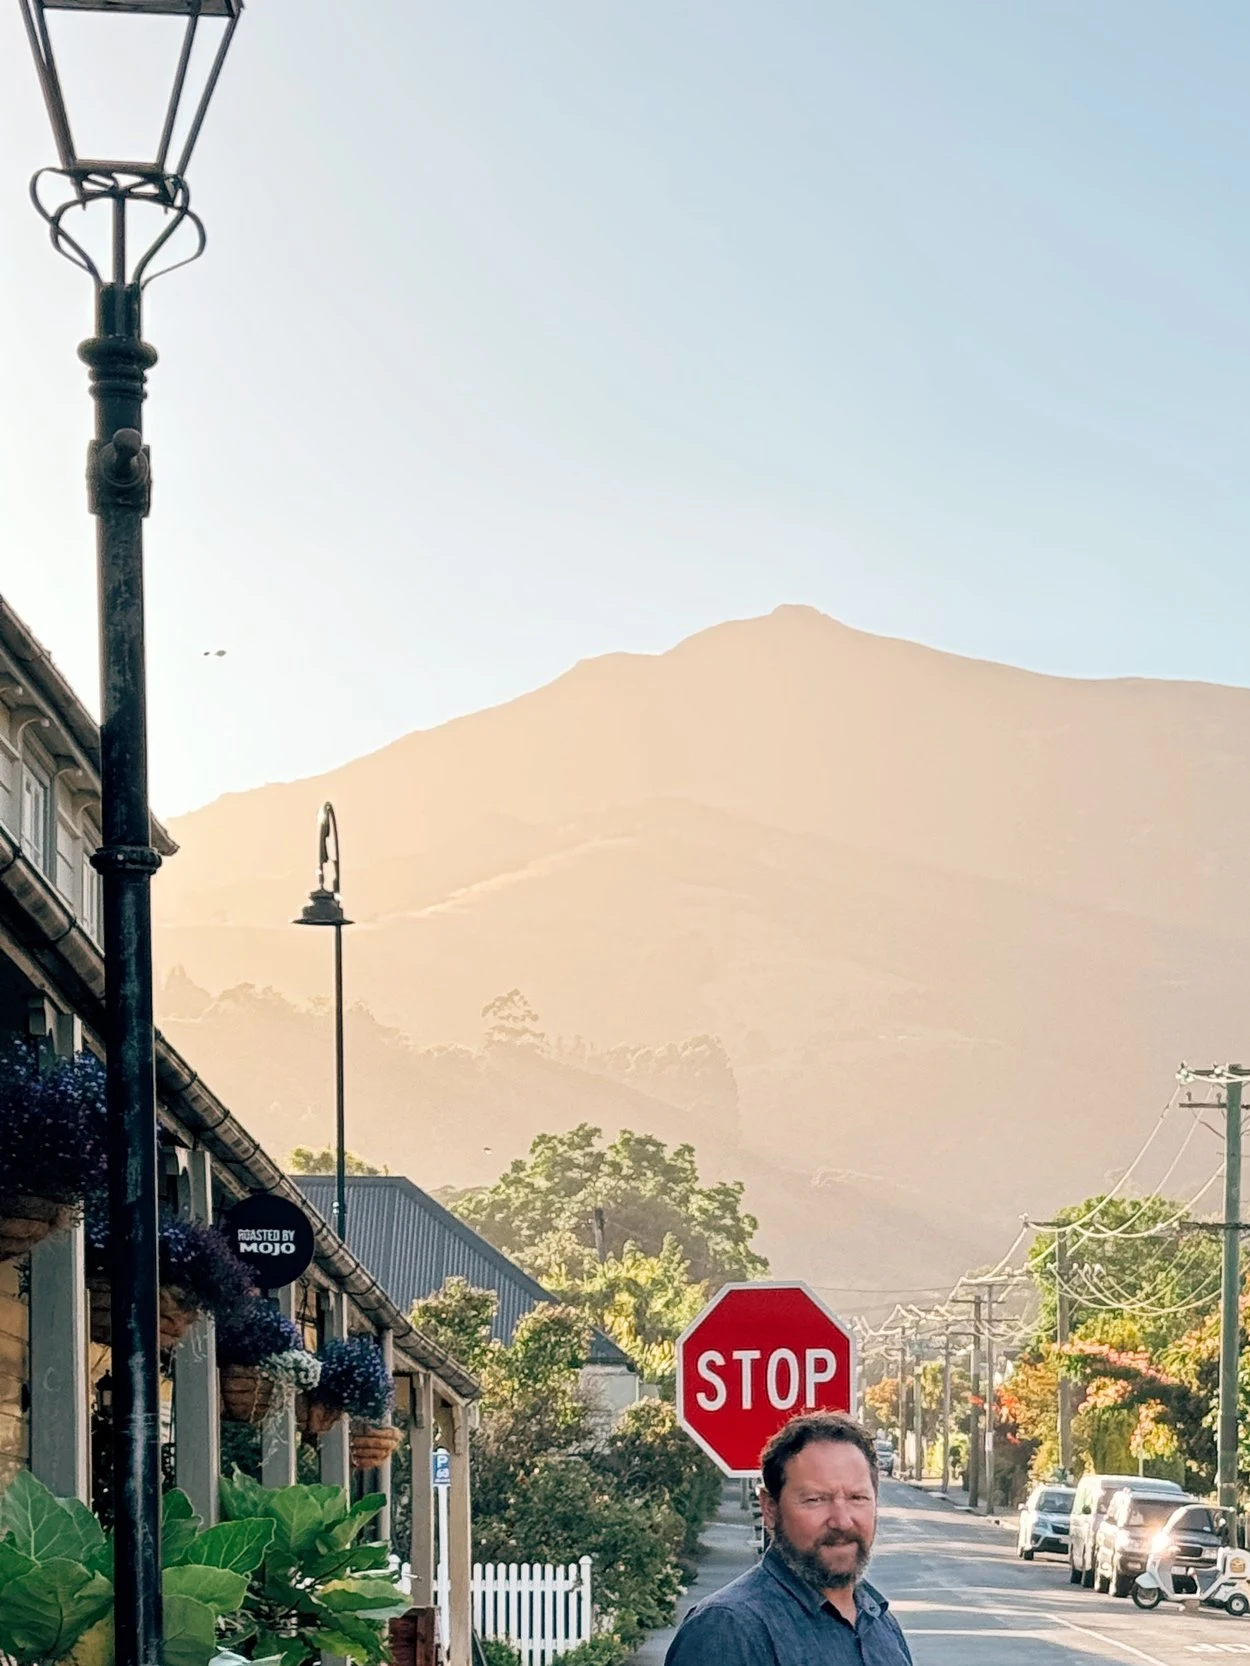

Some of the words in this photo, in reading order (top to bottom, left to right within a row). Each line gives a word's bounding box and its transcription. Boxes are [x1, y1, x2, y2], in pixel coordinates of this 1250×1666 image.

[238, 1229, 280, 1242] ROASTED
[282, 1230, 295, 1242] BY
[239, 1242, 296, 1256] MOJO
[696, 1348, 837, 1411] STOP
[436, 1455, 448, 1468] P
